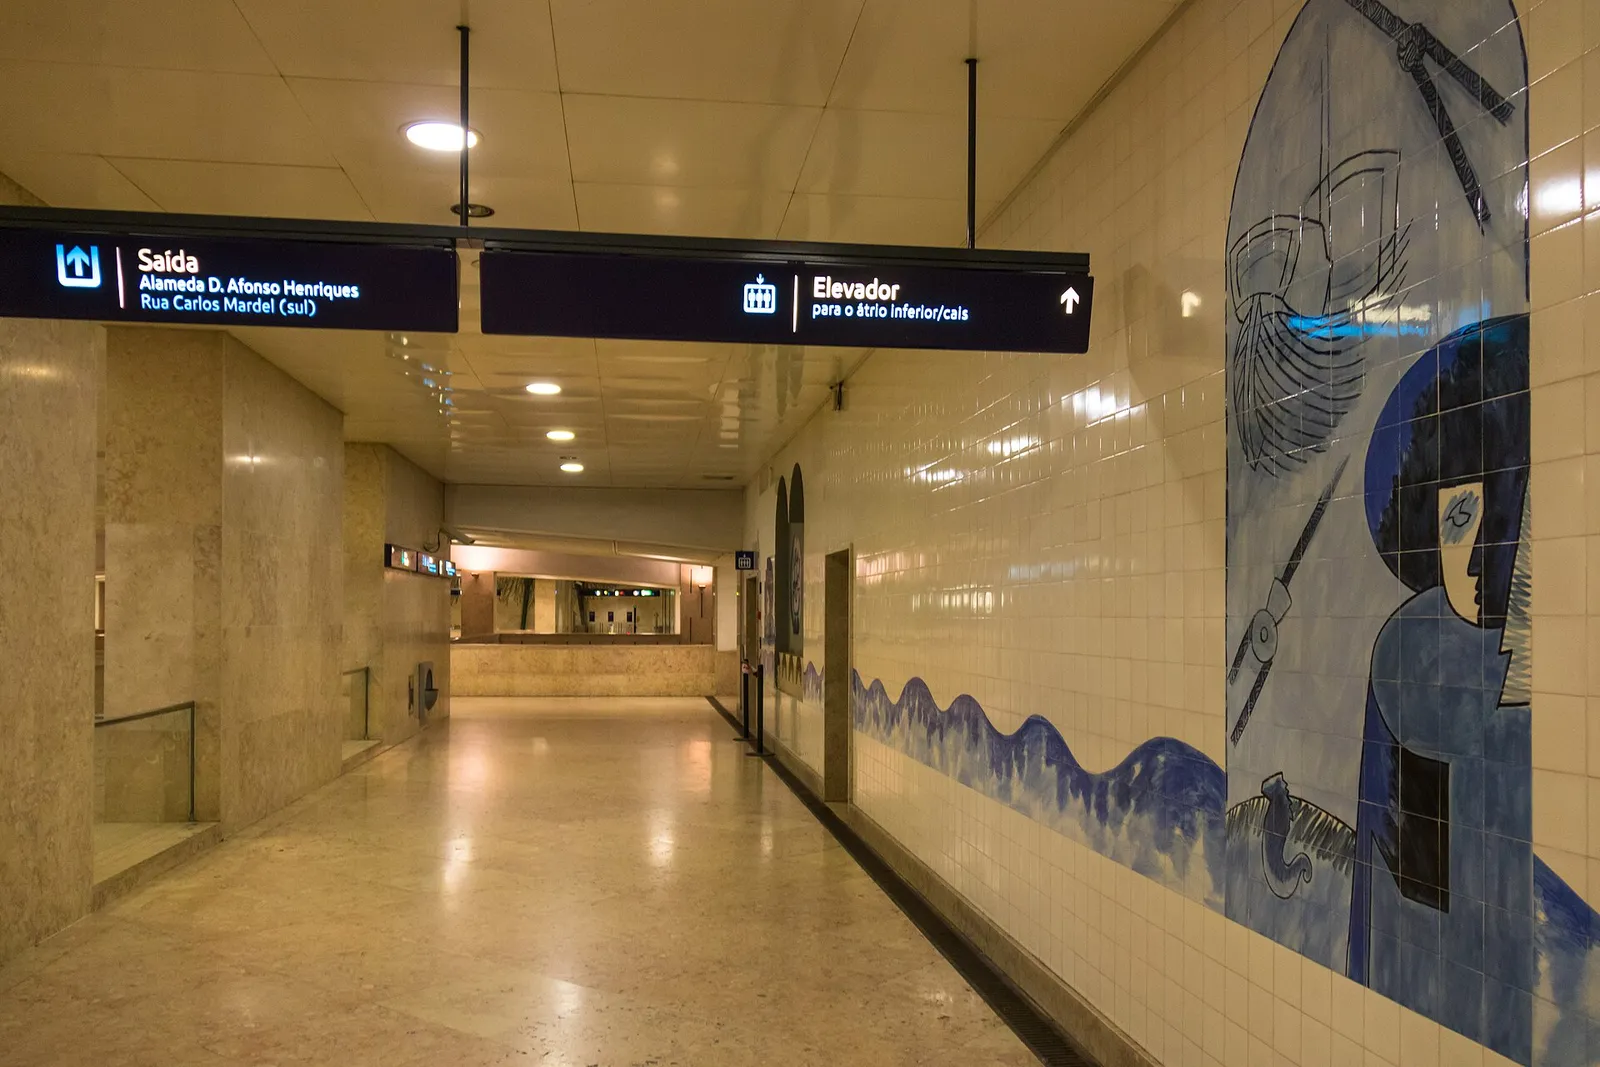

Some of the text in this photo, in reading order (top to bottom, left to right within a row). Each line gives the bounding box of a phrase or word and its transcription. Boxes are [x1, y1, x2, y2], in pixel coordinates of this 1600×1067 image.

[138, 248, 199, 273] Saída
[139, 274, 360, 300] Alameda D. Afonso Henriques
[813, 275, 900, 301] Elevador
[141, 294, 317, 317] Rua Carlos Mardel (sul)
[812, 302, 969, 321] para o átrio inferior/cais
